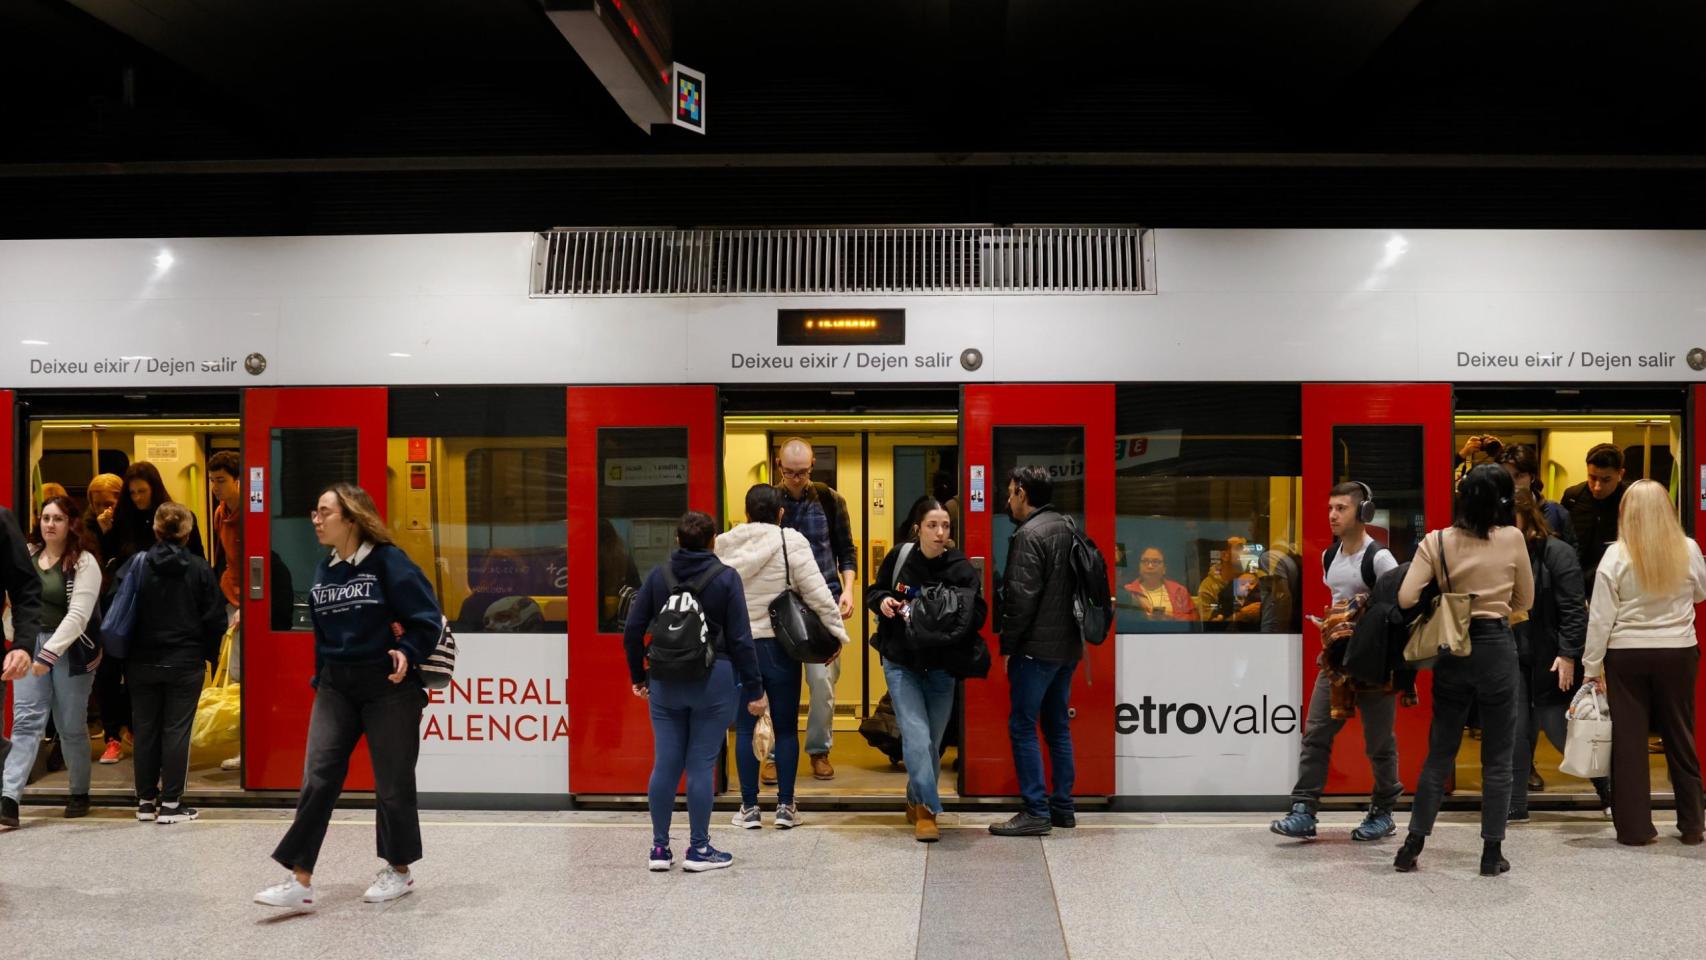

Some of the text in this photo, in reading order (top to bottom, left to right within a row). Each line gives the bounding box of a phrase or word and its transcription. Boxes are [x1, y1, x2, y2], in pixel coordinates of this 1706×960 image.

[31, 356, 238, 377] Deixeu eixir / Dejen salir
[731, 352, 953, 371] Deixeu eixir / Dejen salir
[1457, 351, 1676, 371] Deixeu eixir / Dejen salir
[312, 582, 374, 606] NEWPORT
[1115, 694, 1303, 734] etrovale
[419, 714, 569, 742] ALENCIA
